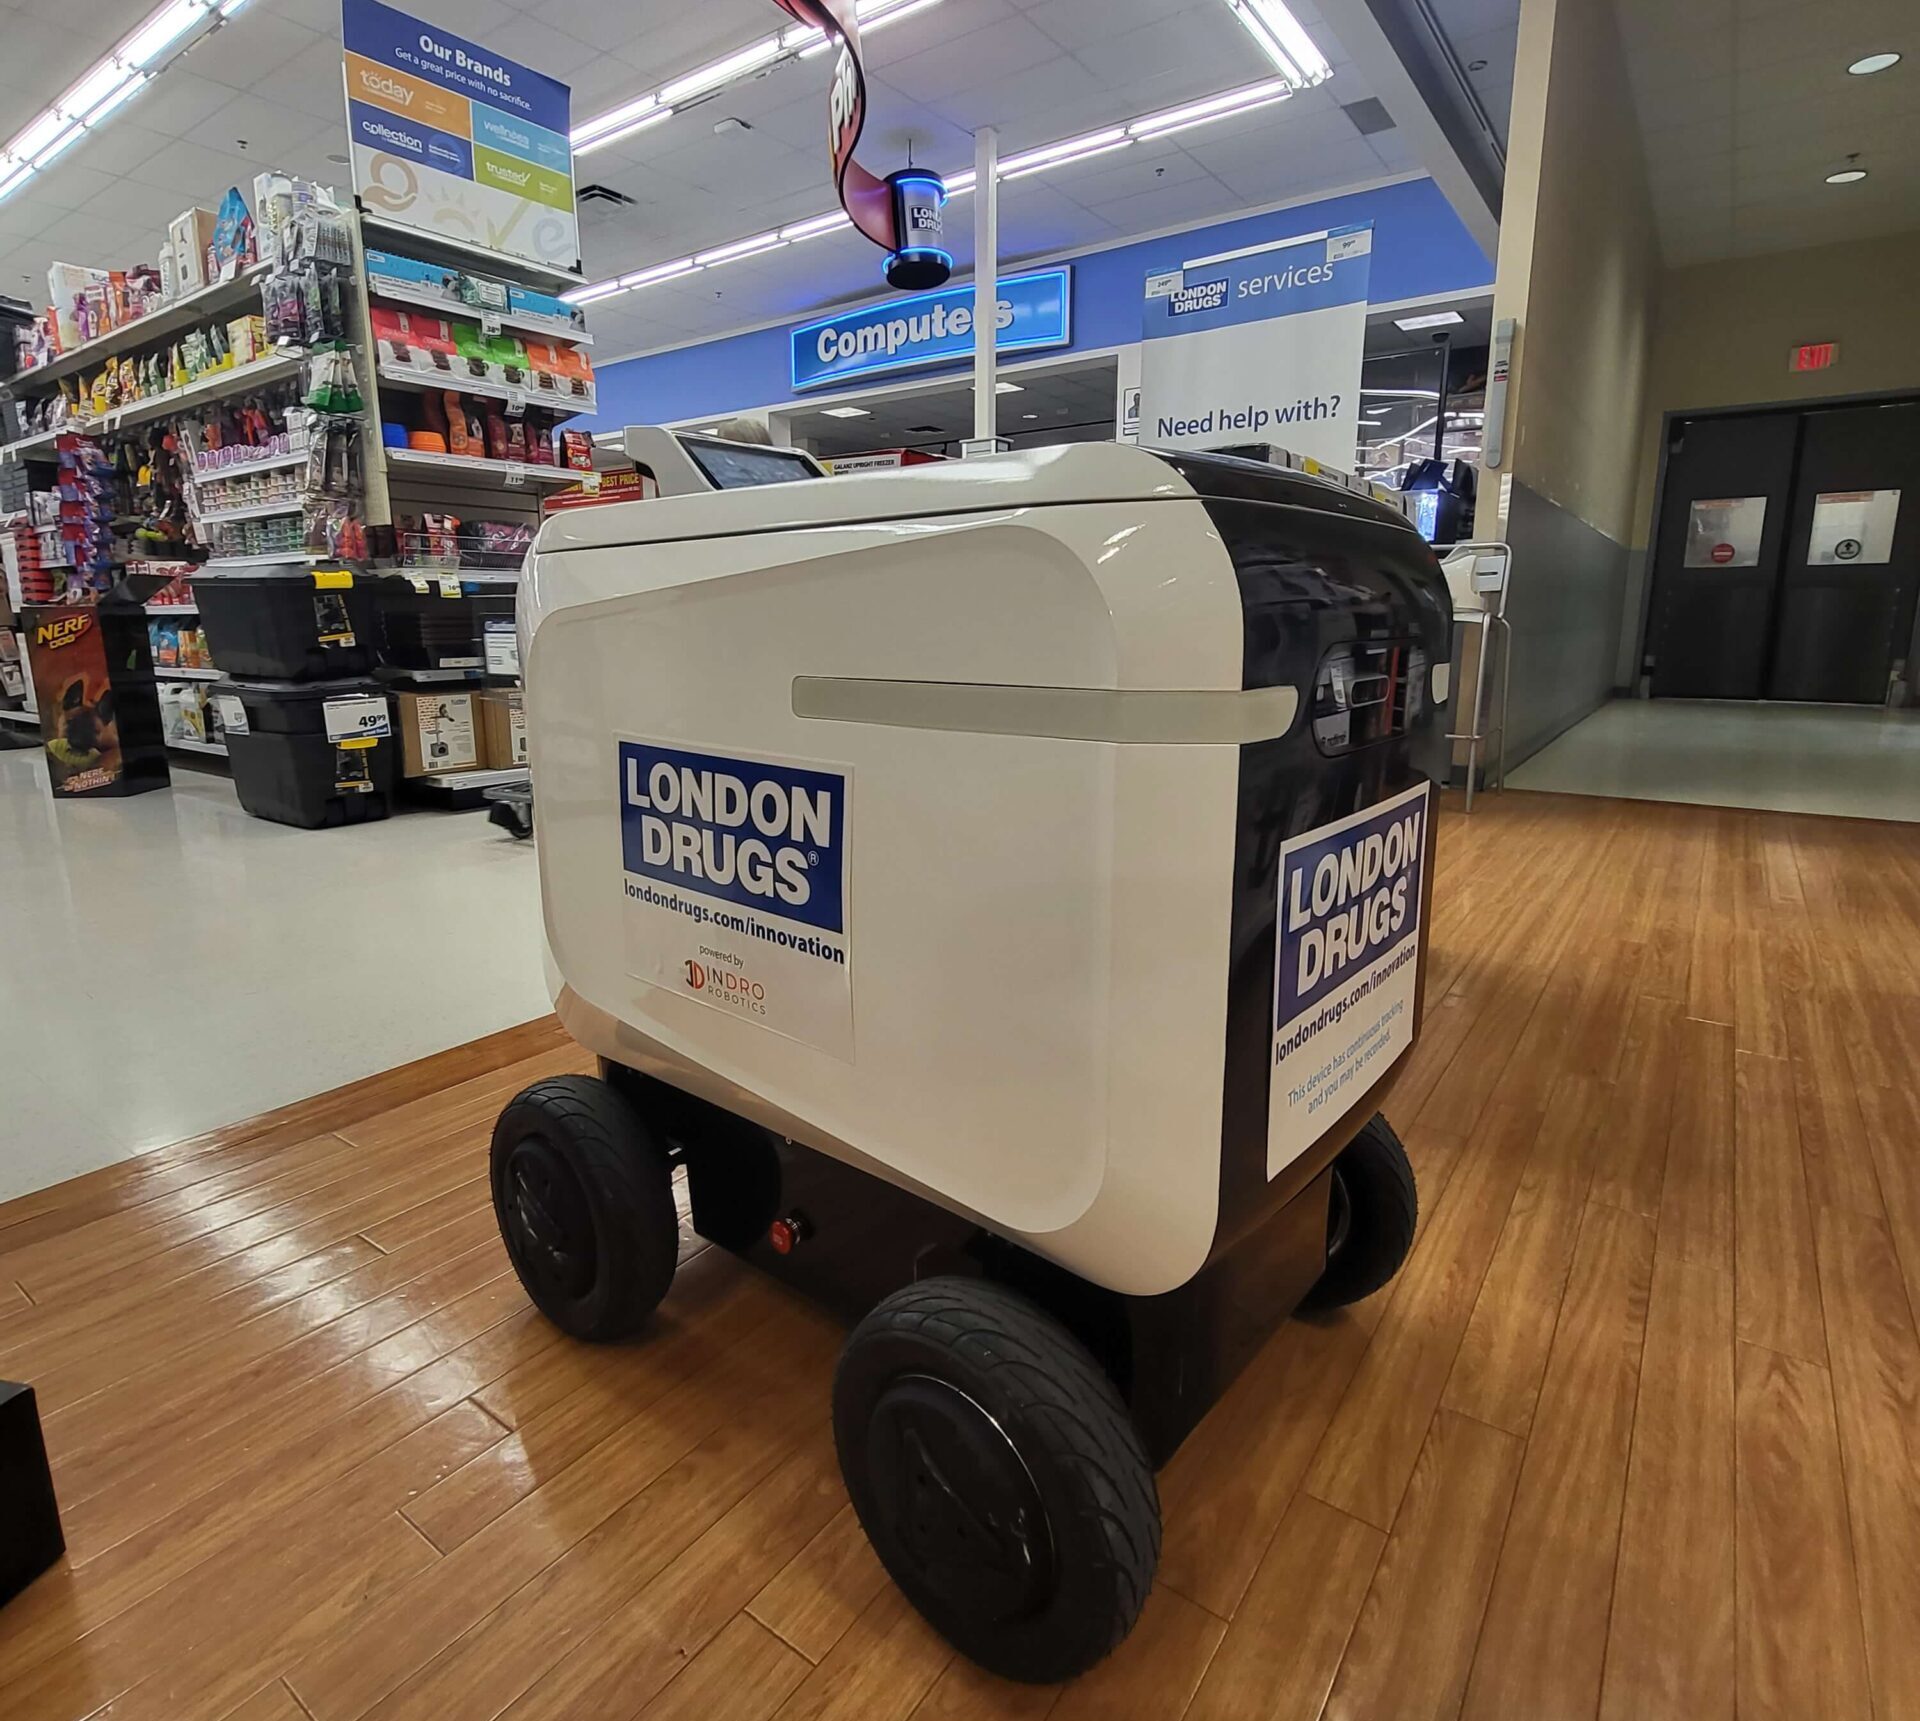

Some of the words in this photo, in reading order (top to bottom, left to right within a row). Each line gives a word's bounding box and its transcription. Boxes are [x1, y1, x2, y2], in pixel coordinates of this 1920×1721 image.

[395, 47, 412, 63] Get
[421, 59, 443, 75] great
[445, 69, 466, 84] price
[467, 79, 486, 92] with
[487, 87, 498, 97] no
[419, 35, 452, 61] Our
[455, 49, 511, 86] Brands
[360, 70, 414, 106] today
[362, 121, 423, 149] collection
[1170, 280, 1227, 302] LONDON
[1237, 262, 1334, 298] services
[817, 299, 1015, 363] Computes
[1797, 344, 1834, 369] EXIT
[1157, 411, 1213, 438] Need
[1219, 405, 1269, 433] help
[1275, 395, 1341, 424] with?
[602, 475, 619, 488] BEST
[619, 473, 639, 486] PRICE
[874, 459, 894, 467] FREEZER
[37, 613, 89, 645] NERF
[627, 757, 831, 848] LONDON
[1288, 811, 1421, 933] LONDON
[624, 878, 844, 964] londondrugs.com/innovation
[1296, 875, 1408, 997] DRUGS
[699, 945, 732, 963] powered
[734, 954, 744, 969] by
[707, 965, 765, 1000] INDRO
[708, 985, 766, 1015] ROBOTICS
[1275, 944, 1416, 1066] londondrugs.com/innovation
[1288, 1083, 1306, 1108] This
[1307, 1063, 1332, 1092] device
[1332, 1052, 1346, 1071] has
[1346, 1020, 1381, 1059] continuous
[1381, 999, 1404, 1027] tracking
[1308, 1088, 1323, 1114] and
[1324, 1081, 1338, 1105] you
[1340, 1062, 1355, 1087] may
[1355, 1056, 1364, 1072] be
